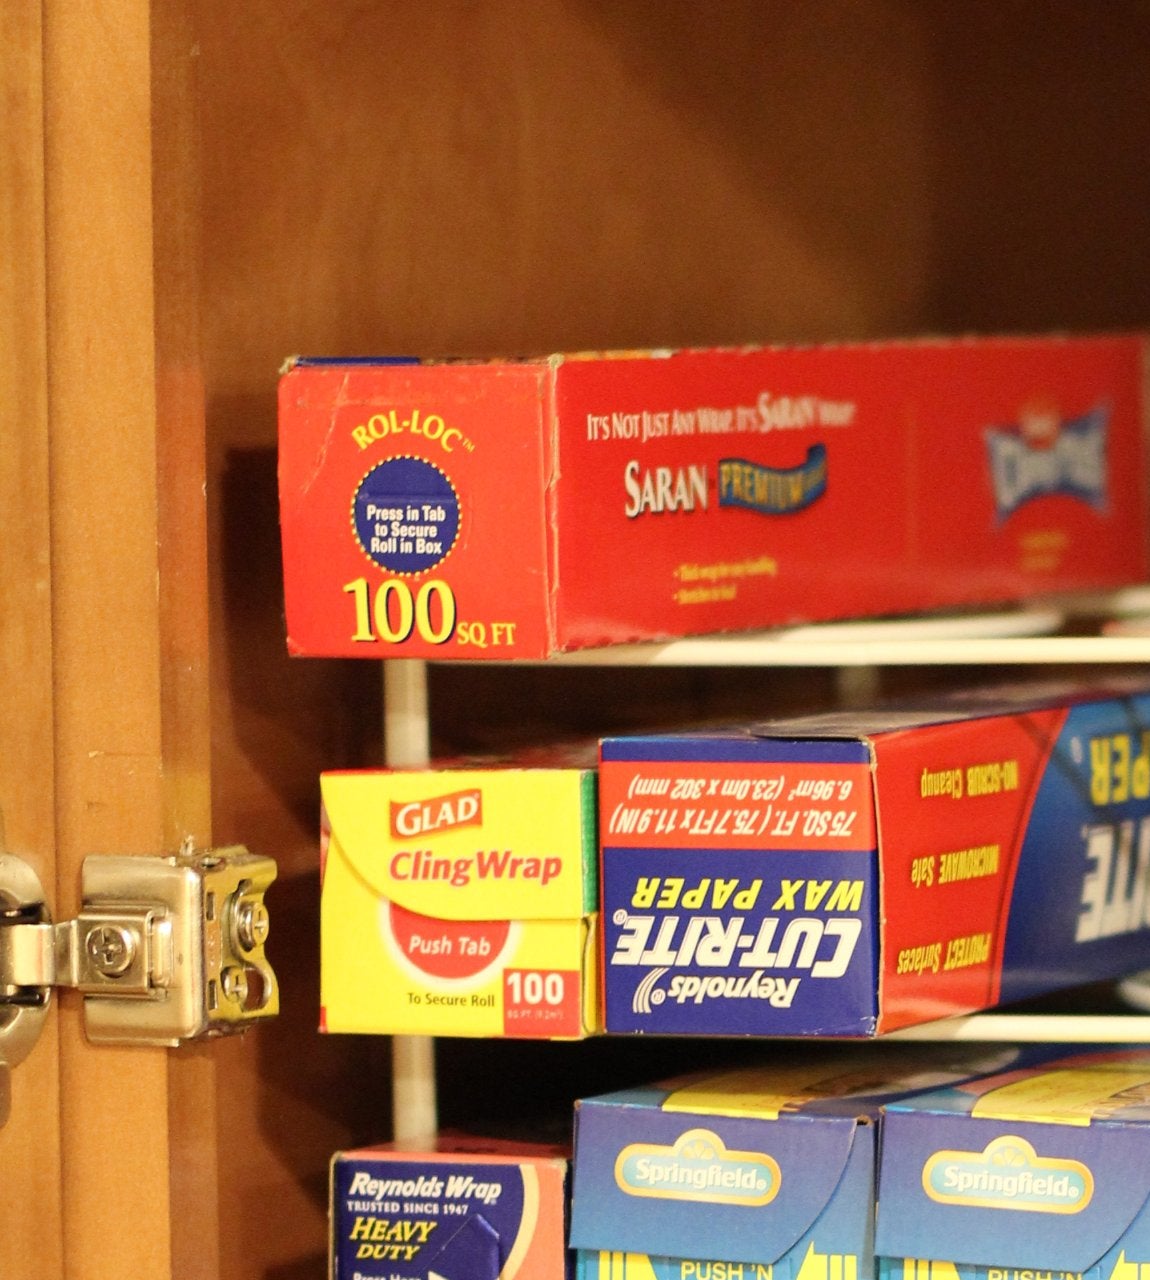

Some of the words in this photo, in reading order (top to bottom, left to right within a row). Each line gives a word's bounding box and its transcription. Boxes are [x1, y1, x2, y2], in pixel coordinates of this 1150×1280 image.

[612, 411, 640, 439] NOT
[642, 410, 670, 443] JUST
[624, 460, 708, 518] SARAN
[366, 504, 403, 522] Press
[406, 504, 420, 521] in
[422, 505, 446, 523] Tab
[374, 523, 388, 537] to
[390, 520, 437, 538] Secure
[370, 538, 397, 554] Roll
[400, 538, 413, 554] in
[415, 538, 442, 555] Box
[342, 576, 457, 645] 100
[457, 622, 488, 648] SQ
[491, 622, 516, 646] FT
[627, 774, 673, 800] mm)
[673, 777, 708, 800] 302
[706, 779, 722, 798] x
[720, 775, 786, 801] (23.0m
[921, 767, 963, 800] Cleanup
[394, 794, 479, 836] GLAD
[911, 855, 936, 889] Safe
[631, 877, 764, 910] PAPER
[771, 879, 865, 912] WAX
[409, 935, 452, 955] Push
[458, 936, 491, 956] Tab
[897, 942, 942, 976] Surfaces
[943, 932, 992, 971] PROTECT
[408, 992, 421, 1005] To
[425, 993, 467, 1006] Secure
[471, 994, 496, 1007] Roll
[507, 972, 565, 1005] 100
[348, 1172, 444, 1201] Reynolds
[445, 1176, 502, 1204] Wrap
[346, 1200, 400, 1213] TRUSTED
[403, 1201, 439, 1214] SINCE
[443, 1203, 469, 1215] 1947
[349, 1216, 437, 1242] HEAVY
[355, 1243, 420, 1260] DUTY
